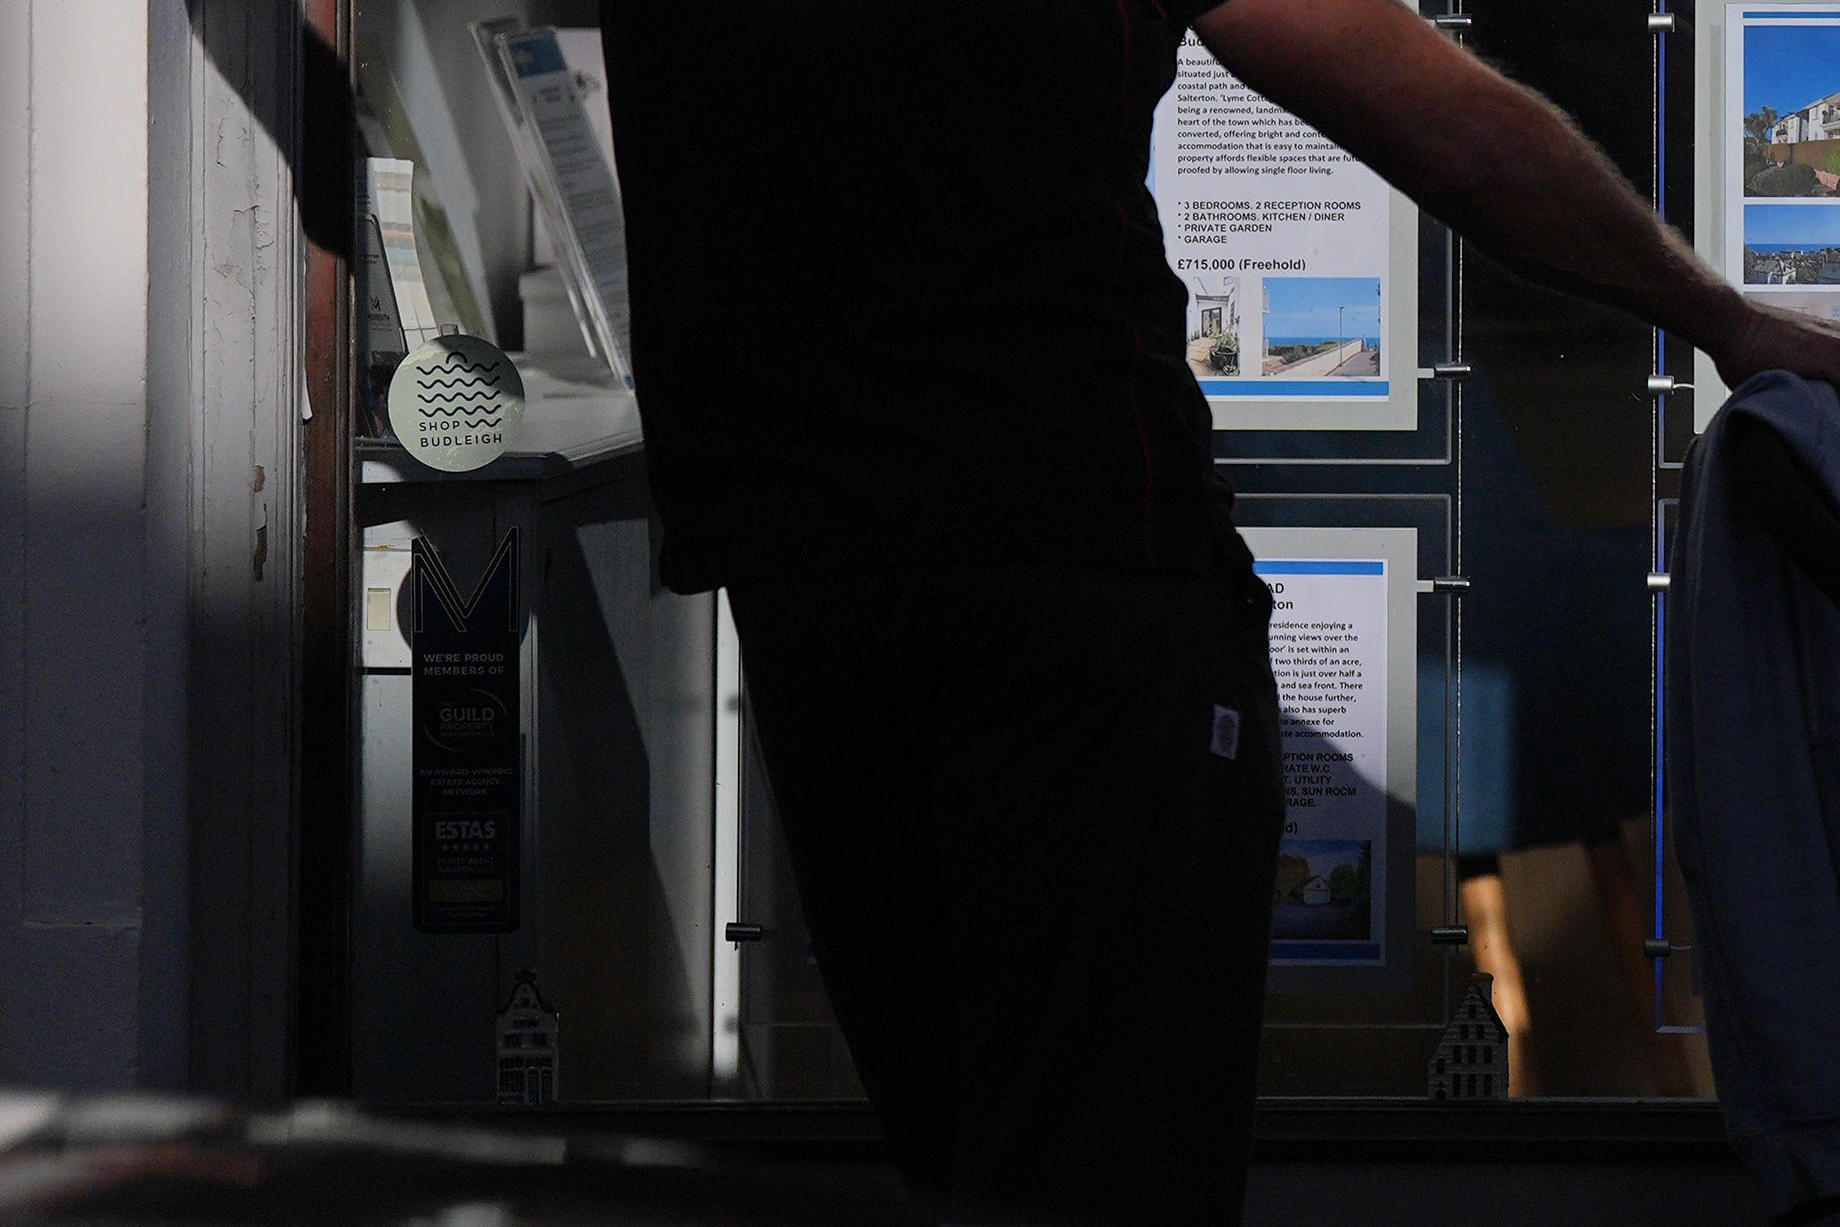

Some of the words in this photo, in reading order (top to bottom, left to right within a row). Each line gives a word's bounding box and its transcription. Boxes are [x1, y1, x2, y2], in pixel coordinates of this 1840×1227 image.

[1177, 165, 1211, 175] proofed
[1212, 165, 1223, 176] by
[1224, 166, 1260, 176] allowing
[1261, 166, 1286, 176] single
[1287, 166, 1308, 175] floor
[1184, 201, 1190, 210] 3
[1255, 201, 1262, 210] 2
[1263, 201, 1322, 210] RECEPTION
[1323, 201, 1361, 211] ROOMS
[1184, 223, 1227, 233] PRIVATE
[1228, 223, 1273, 233] GARDEN
[1183, 235, 1227, 244] GARAGE
[1177, 258, 1235, 271] £715,000
[1238, 258, 1306, 271] (Freehold)
[418, 420, 461, 433] SHOP
[420, 433, 503, 448] BUDLEIGH
[1270, 621, 1309, 630] residence
[1310, 621, 1346, 632] enjoying
[423, 653, 460, 663] WE'RE
[464, 653, 504, 663] PROUD
[1274, 658, 1292, 666] two
[1292, 657, 1318, 666] thirds
[1318, 657, 1328, 666] of
[423, 666, 485, 676] MEMBERS
[488, 666, 505, 675] OF
[439, 707, 495, 722] GUILD
[434, 820, 497, 839] ESTAS
